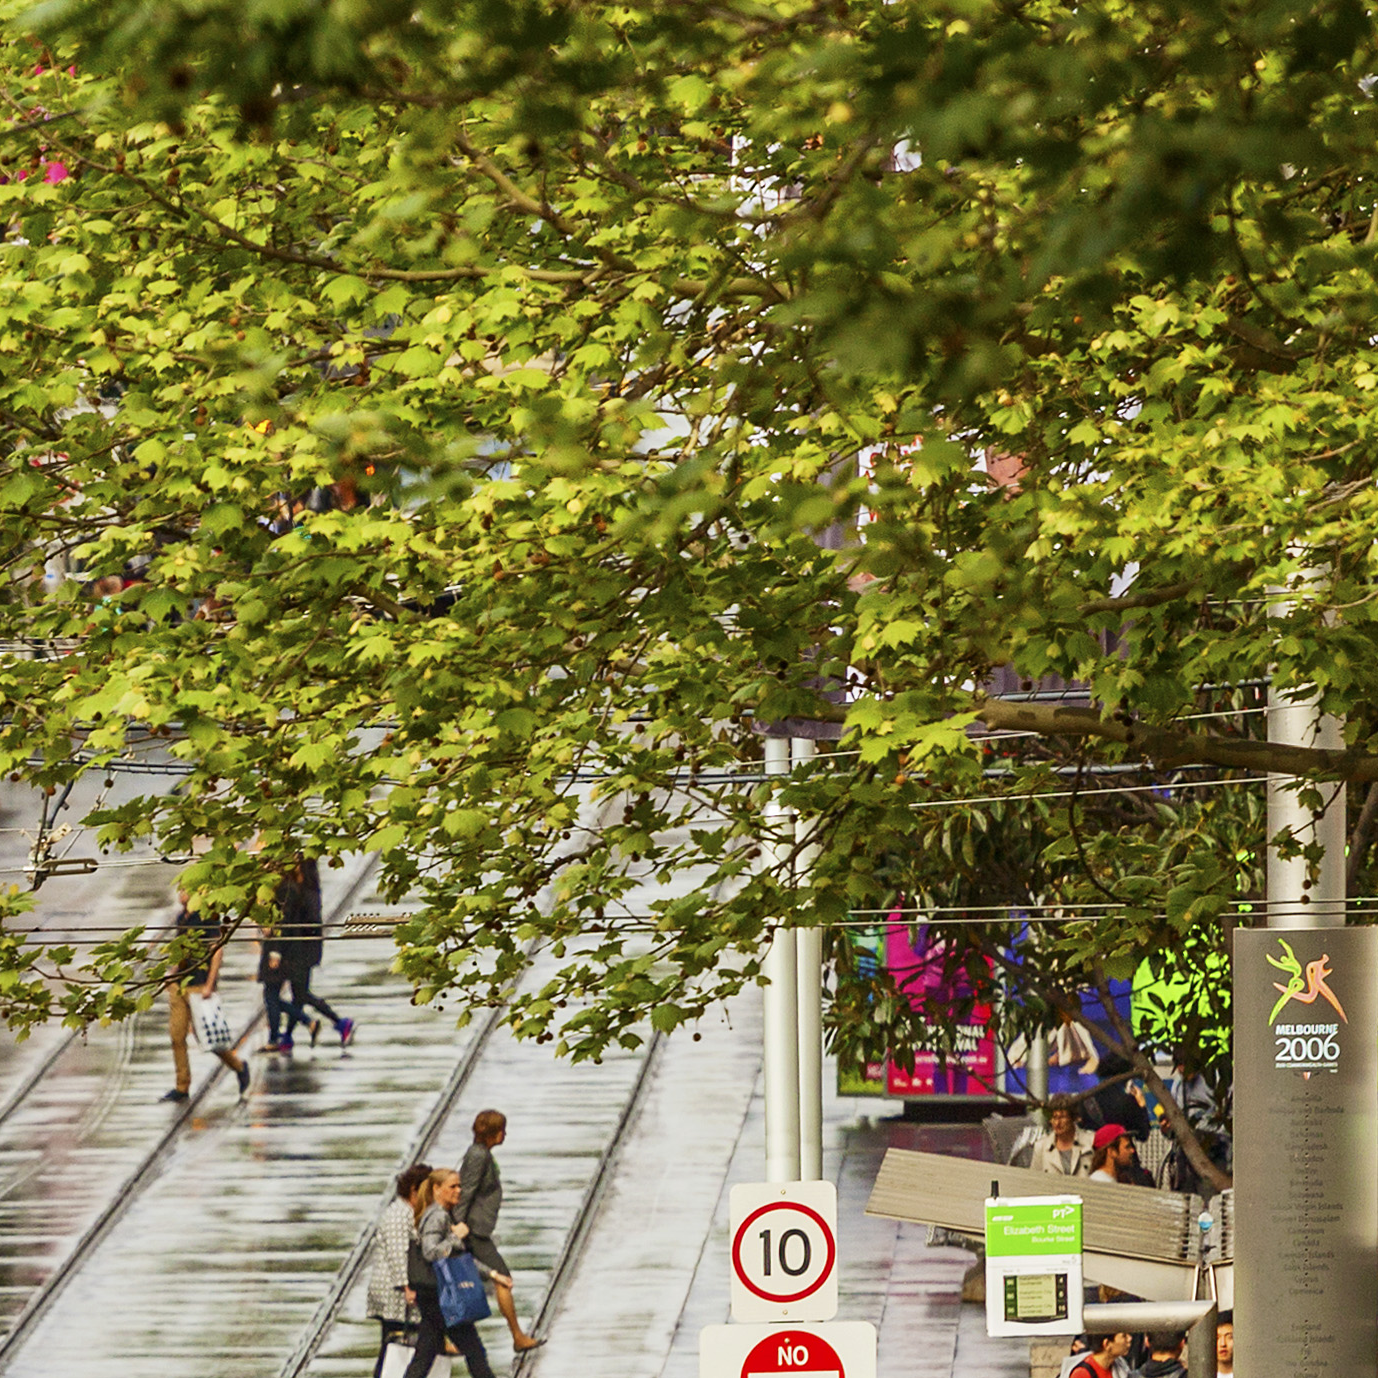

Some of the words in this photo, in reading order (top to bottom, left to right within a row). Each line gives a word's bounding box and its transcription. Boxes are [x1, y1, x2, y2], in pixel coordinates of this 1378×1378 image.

[1275, 1023, 1339, 1035] MELBOURNE
[1275, 1031, 1341, 1061] 2006
[1003, 1224, 1045, 1235] Elizabeth
[1047, 1224, 1075, 1234] Street
[759, 1228, 811, 1277] 10
[777, 1345, 809, 1366] NO
